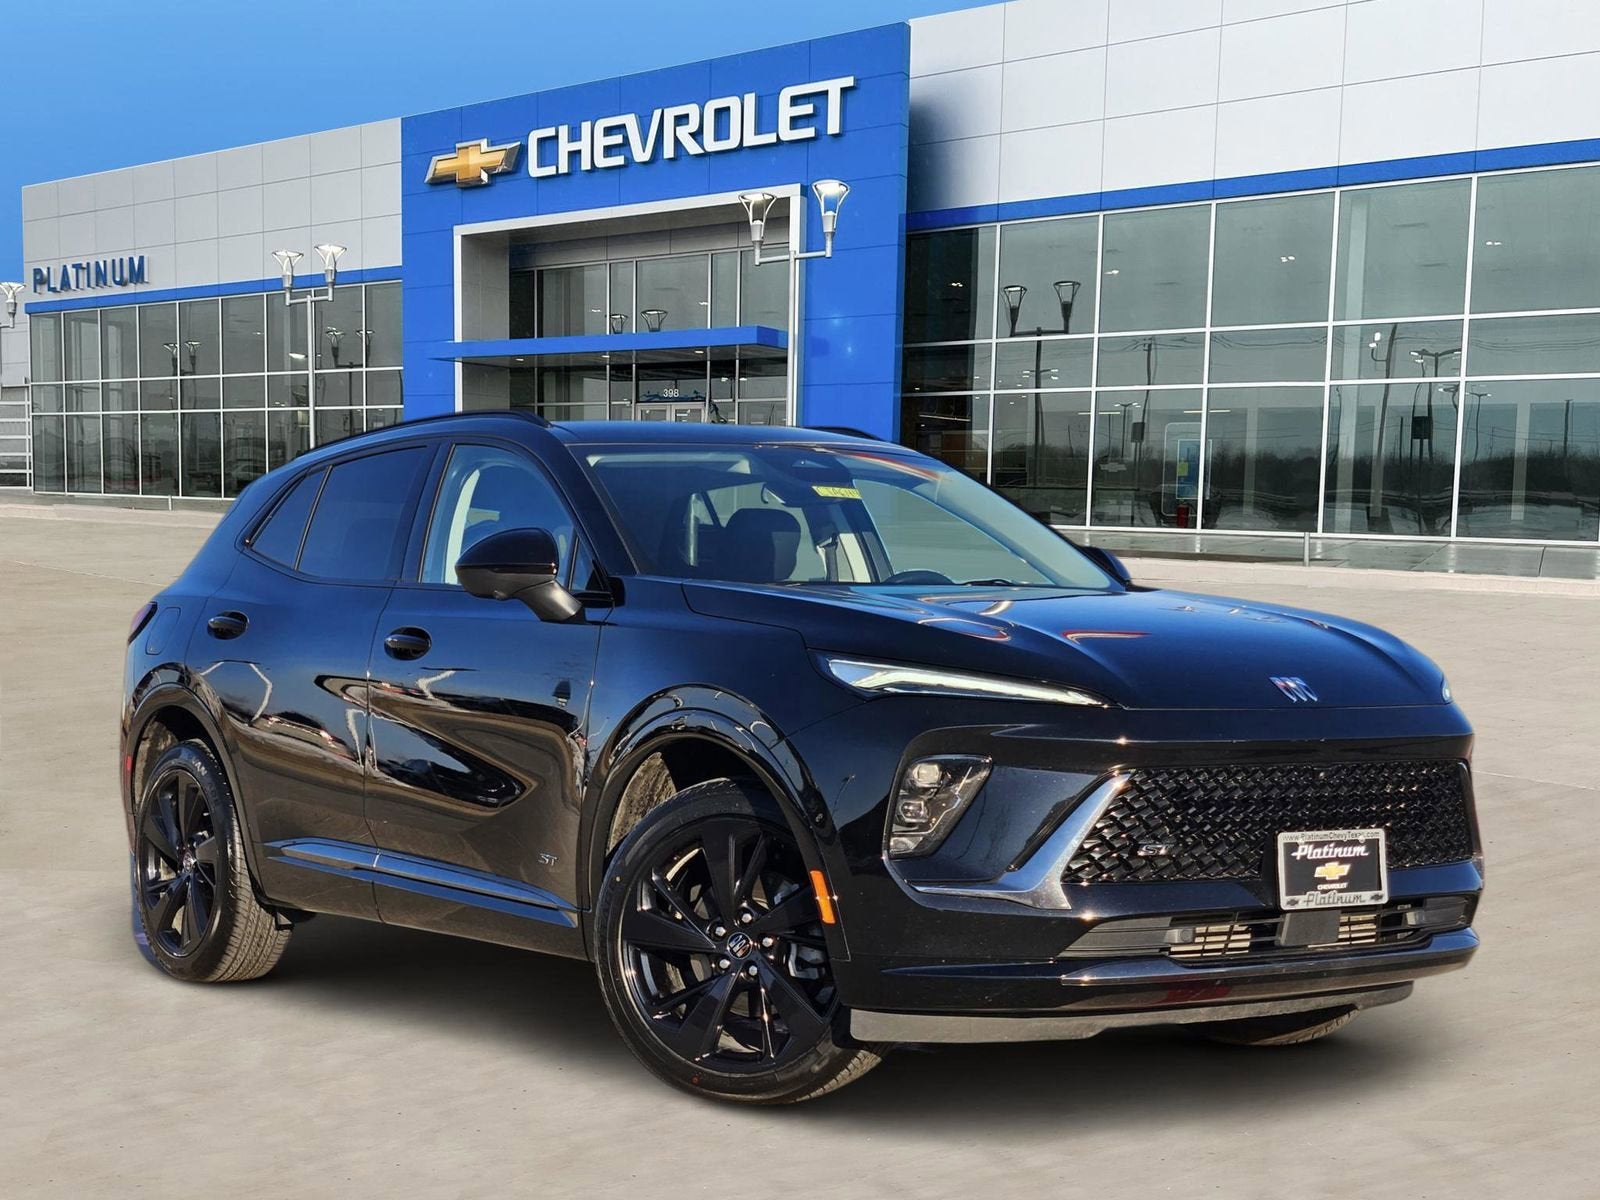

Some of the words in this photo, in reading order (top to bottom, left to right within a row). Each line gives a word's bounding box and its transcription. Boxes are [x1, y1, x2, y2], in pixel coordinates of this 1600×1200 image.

[527, 75, 856, 178] CHEVROLET
[33, 255, 146, 294] PLATINUM
[663, 388, 679, 398] 398
[1291, 843, 1369, 860] Platinum
[1304, 891, 1366, 906] Platinum
